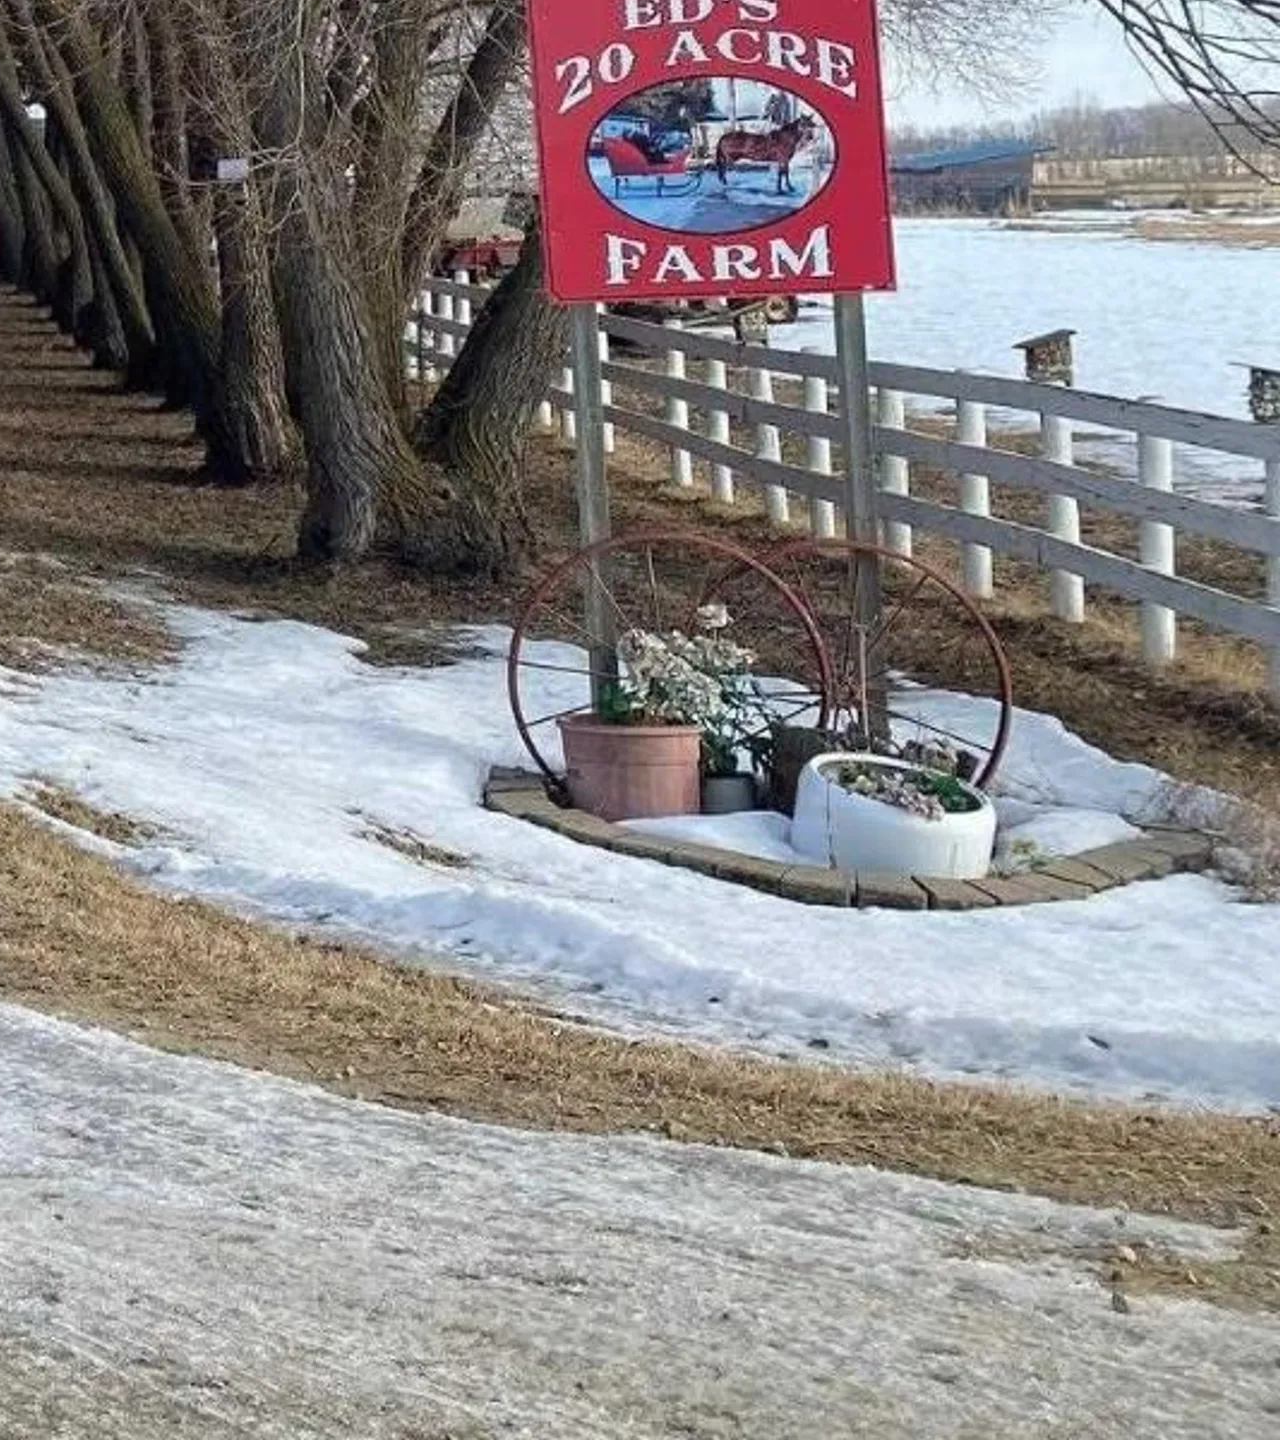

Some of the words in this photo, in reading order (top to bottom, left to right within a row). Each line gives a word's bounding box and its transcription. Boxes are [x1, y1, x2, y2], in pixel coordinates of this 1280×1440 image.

[555, 42, 635, 115] 20
[665, 28, 857, 99] ACRE
[604, 224, 835, 286] FARM
